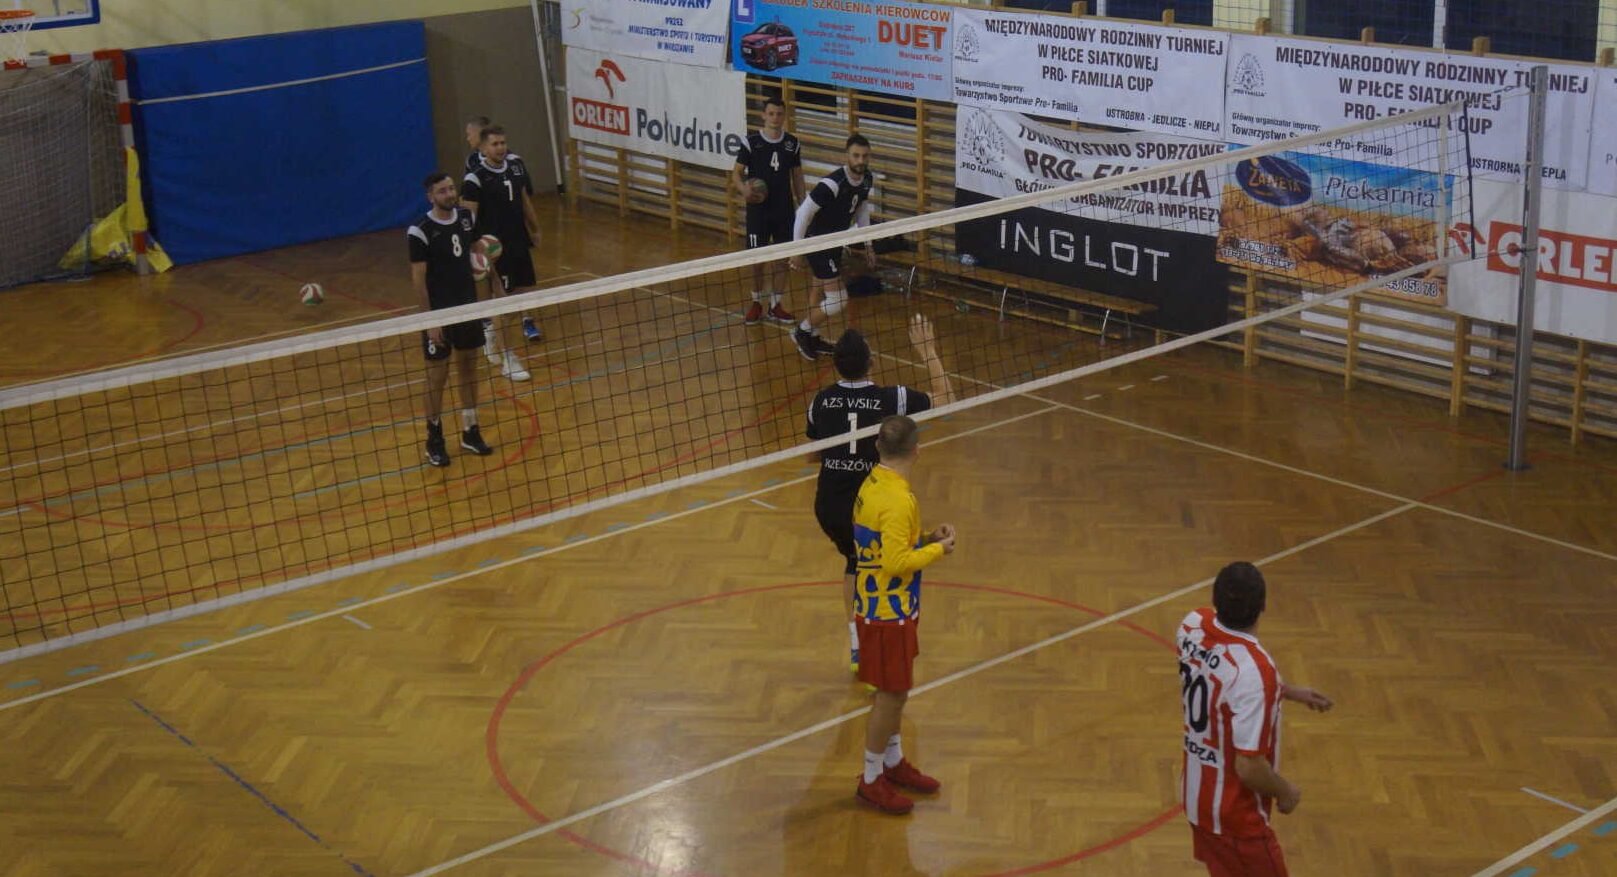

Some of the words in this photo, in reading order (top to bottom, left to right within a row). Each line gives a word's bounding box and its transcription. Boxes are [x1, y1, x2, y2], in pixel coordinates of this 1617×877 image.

[813, 0, 872, 15] SZKOLENIA
[878, 20, 947, 49] DUET
[985, 19, 1096, 43] MIĘDZYNARODOWY
[1100, 29, 1162, 50] RODZINNY
[1166, 36, 1223, 56] TURNIEJ
[1038, 44, 1049, 58] W
[1051, 47, 1084, 64] PIŁCE
[1087, 50, 1159, 71] SIATKOWEJ
[1275, 46, 1422, 76] MIĘDZYNARODOWY
[1425, 61, 1507, 87] RODZINNY
[1514, 70, 1589, 94] TUNIEJ
[831, 71, 878, 85] ZAPRASZAMY
[881, 78, 892, 88] NA
[894, 79, 915, 91] KURS
[1072, 70, 1124, 90] FAMILIA
[1127, 76, 1153, 92] CUP
[1339, 77, 1352, 94] W
[1357, 79, 1404, 99] PIŁCE
[1408, 85, 1502, 111] SIATKOWEJ
[955, 87, 997, 101] Towarzystwo
[999, 93, 1033, 105] Sportowe
[1052, 100, 1078, 112] Familia
[1344, 102, 1381, 121] PRO-
[574, 104, 626, 130] ORLEN
[1106, 108, 1145, 122] USTROBNA
[1152, 113, 1186, 128] JEDLICZE
[1193, 120, 1220, 133] NIEPLA
[636, 107, 742, 156] Południe
[1018, 124, 1131, 157] TOWARZYSTWO
[1136, 142, 1225, 160] SPORTOWE
[1232, 123, 1286, 140] Towarzystwo
[1357, 141, 1393, 156] Familia
[770, 151, 779, 171] 4
[1024, 148, 1083, 181] PRO-
[1470, 158, 1520, 174] USTROBNA
[452, 234, 462, 257] 8
[1000, 219, 1170, 281] INGLOT
[822, 397, 843, 408] AZS
[848, 412, 857, 454] 1
